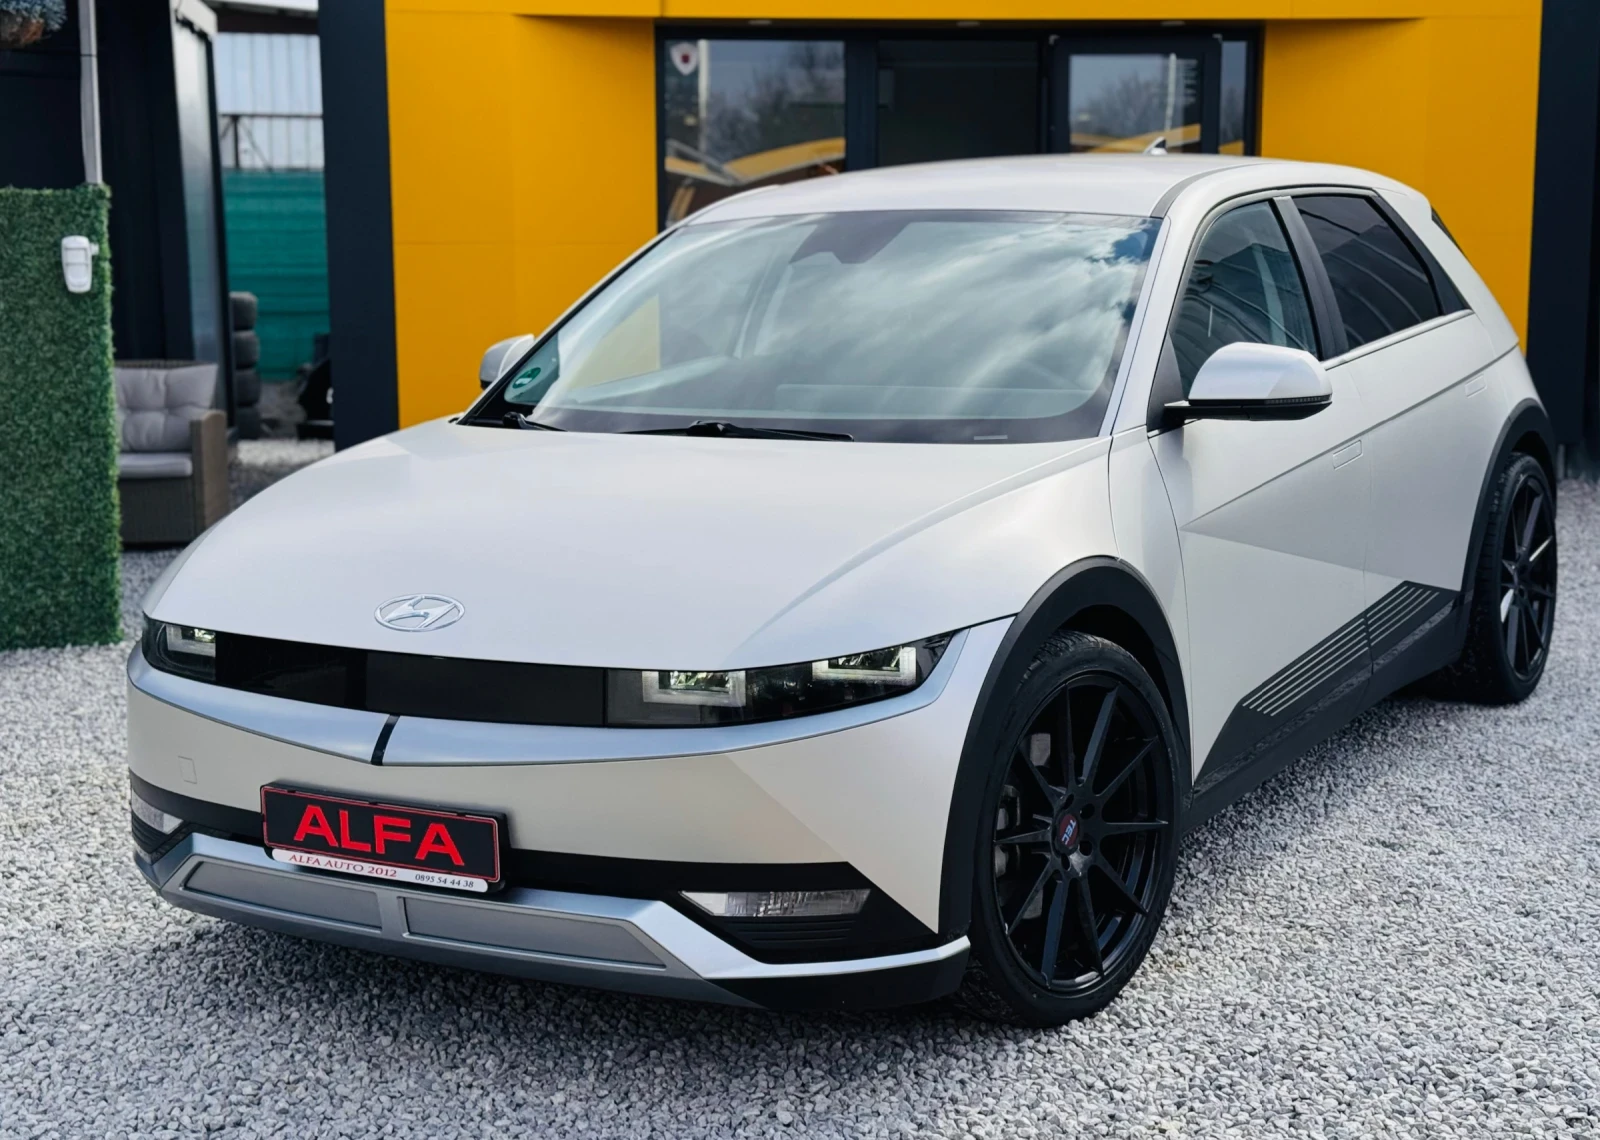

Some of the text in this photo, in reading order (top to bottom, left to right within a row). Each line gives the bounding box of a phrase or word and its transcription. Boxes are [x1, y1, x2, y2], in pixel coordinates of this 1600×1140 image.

[294, 804, 465, 866] ALFA
[1061, 819, 1077, 846] TEC
[289, 854, 398, 878] ALFA AUTO 2012
[414, 873, 475, 889] 0895 54 44 38
